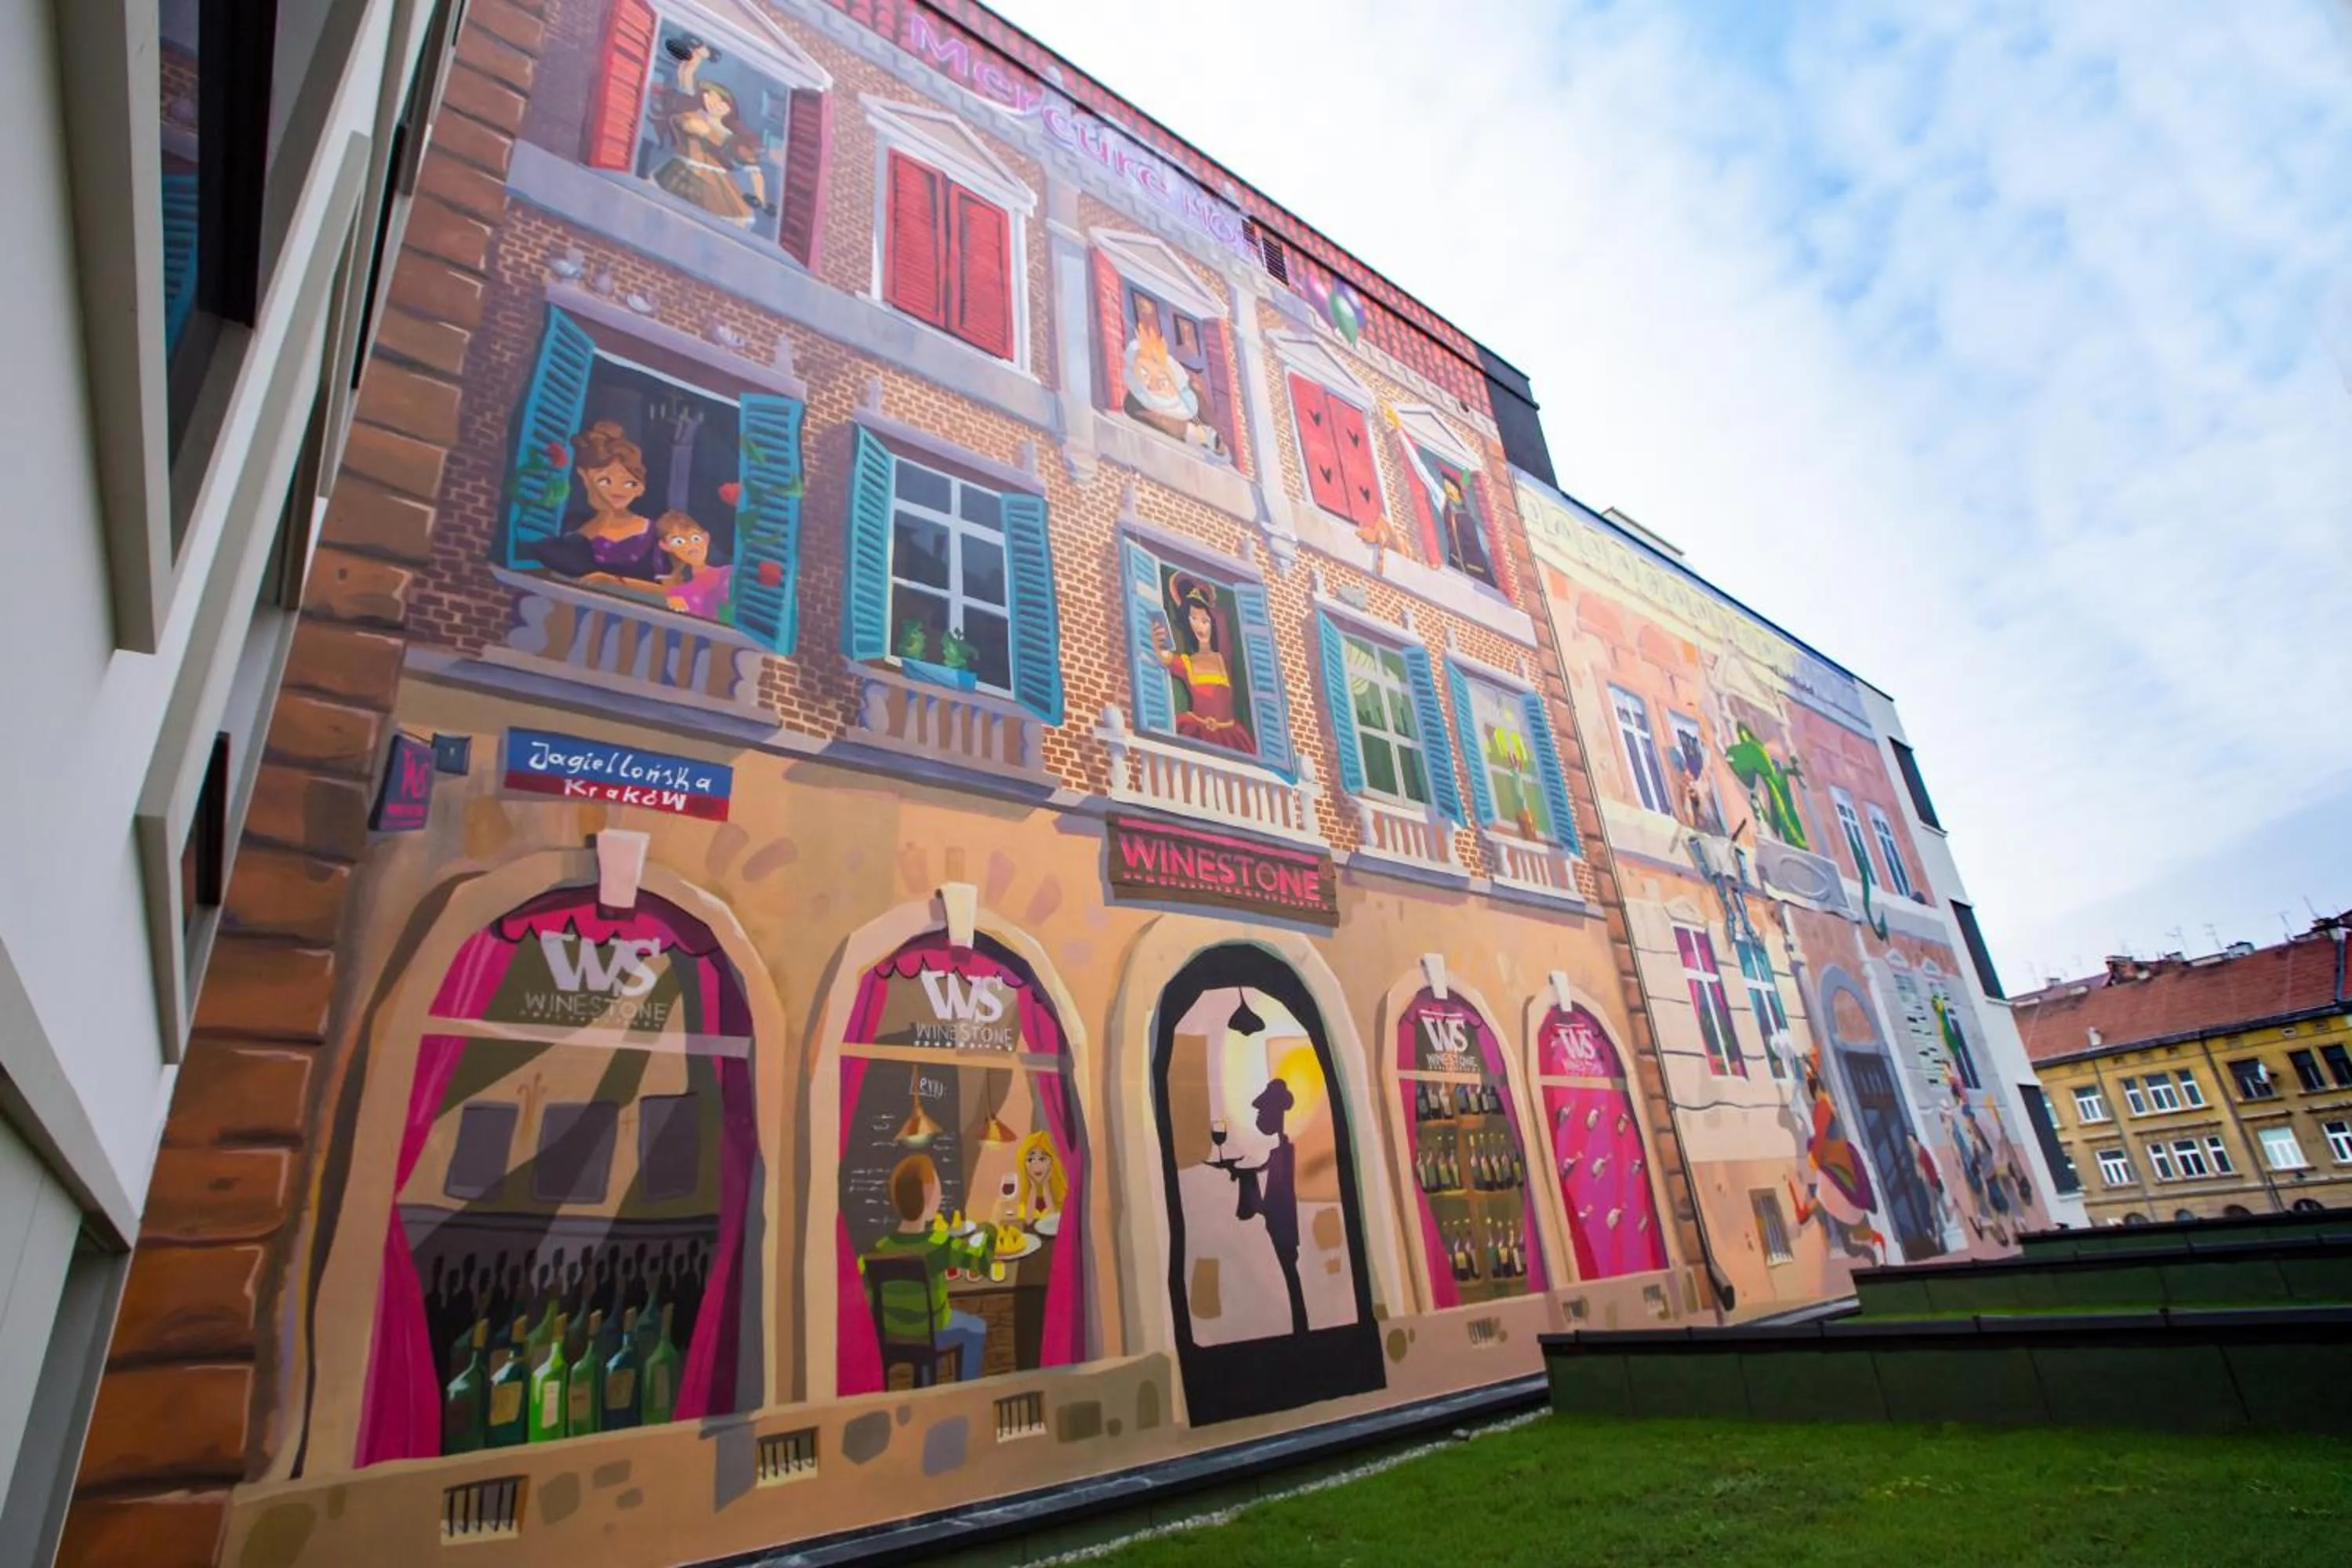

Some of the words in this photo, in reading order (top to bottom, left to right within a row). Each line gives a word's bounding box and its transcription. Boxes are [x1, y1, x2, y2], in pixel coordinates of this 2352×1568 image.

[528, 741, 712, 793] Jagiellońska
[1118, 831, 1322, 902] WINESTONE
[540, 929, 661, 998] WS
[524, 990, 667, 1022] WINESTONE
[920, 969, 1004, 1025] WS
[916, 1022, 1014, 1047] WINESTONE
[1421, 1015, 1468, 1054] WS
[1557, 1027, 1596, 1060] WS
